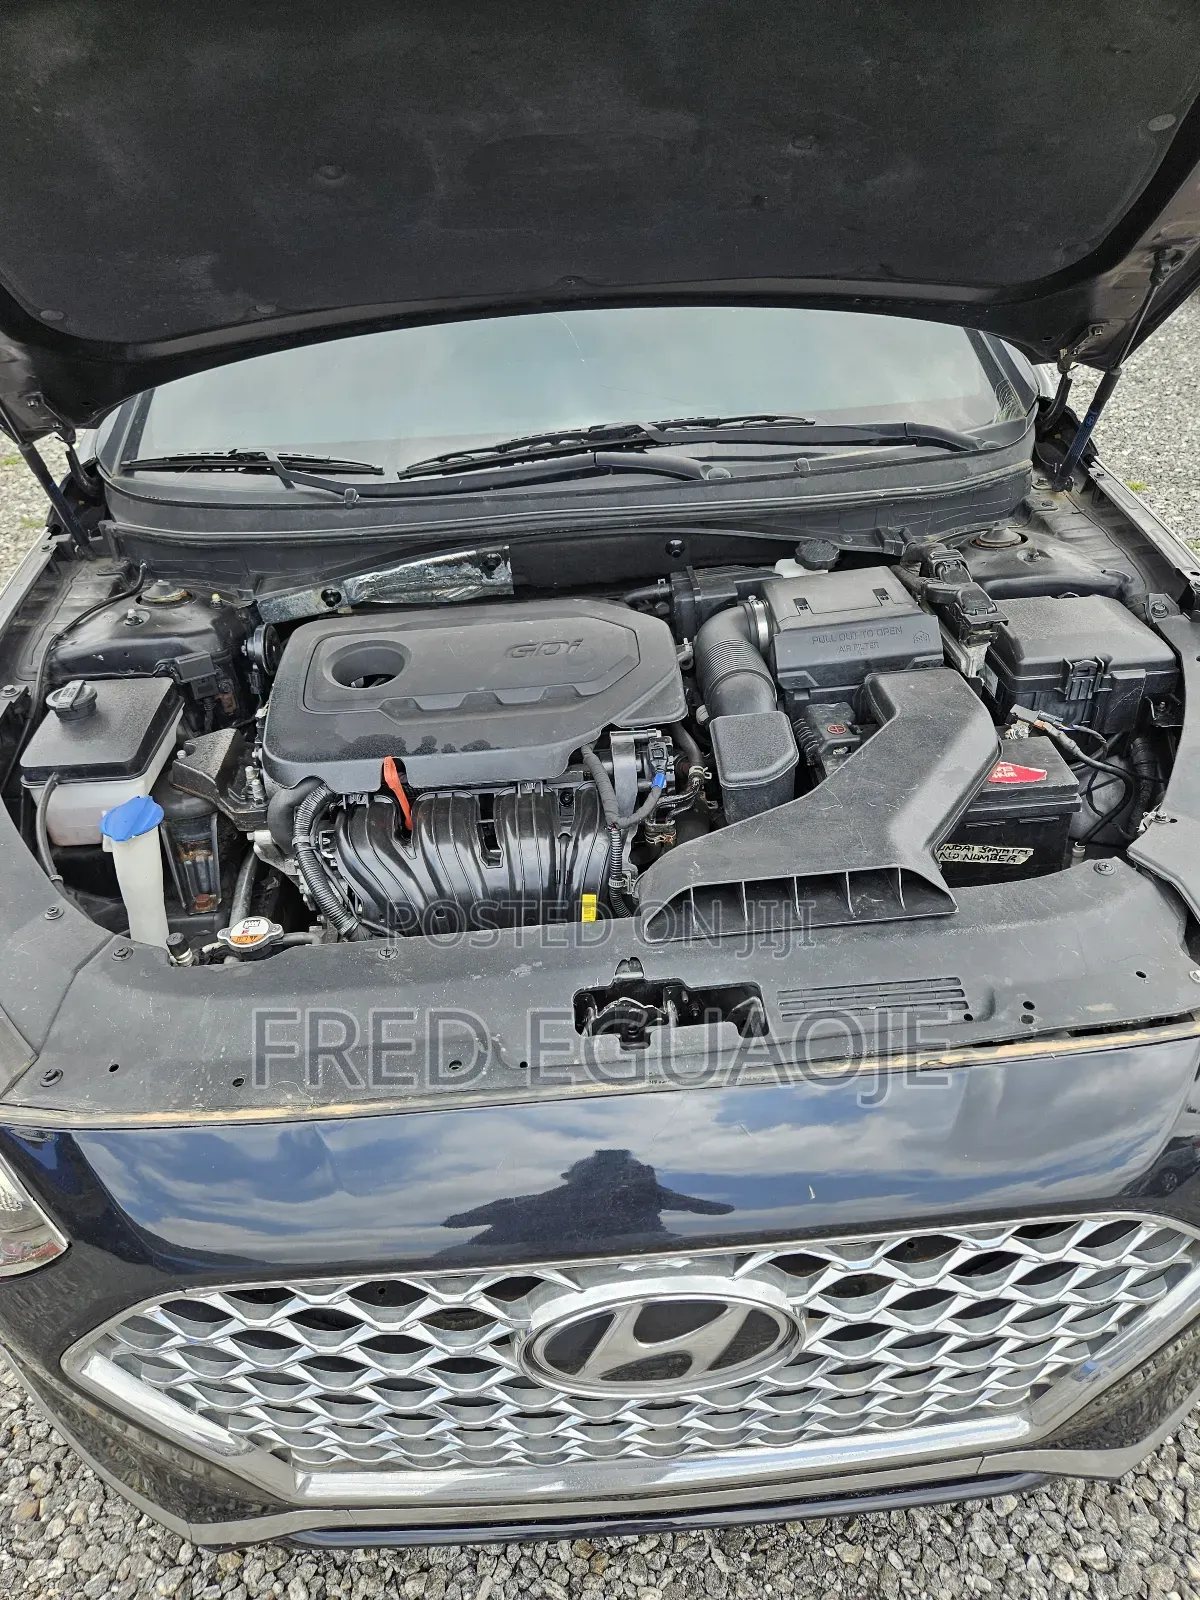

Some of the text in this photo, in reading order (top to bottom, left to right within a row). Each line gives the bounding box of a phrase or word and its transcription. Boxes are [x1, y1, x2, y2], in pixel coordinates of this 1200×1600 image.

[811, 626, 903, 644] PULL OUT TO OPEN
[838, 642, 880, 653] AIR FILTER
[963, 853, 1017, 862] NUMBER
